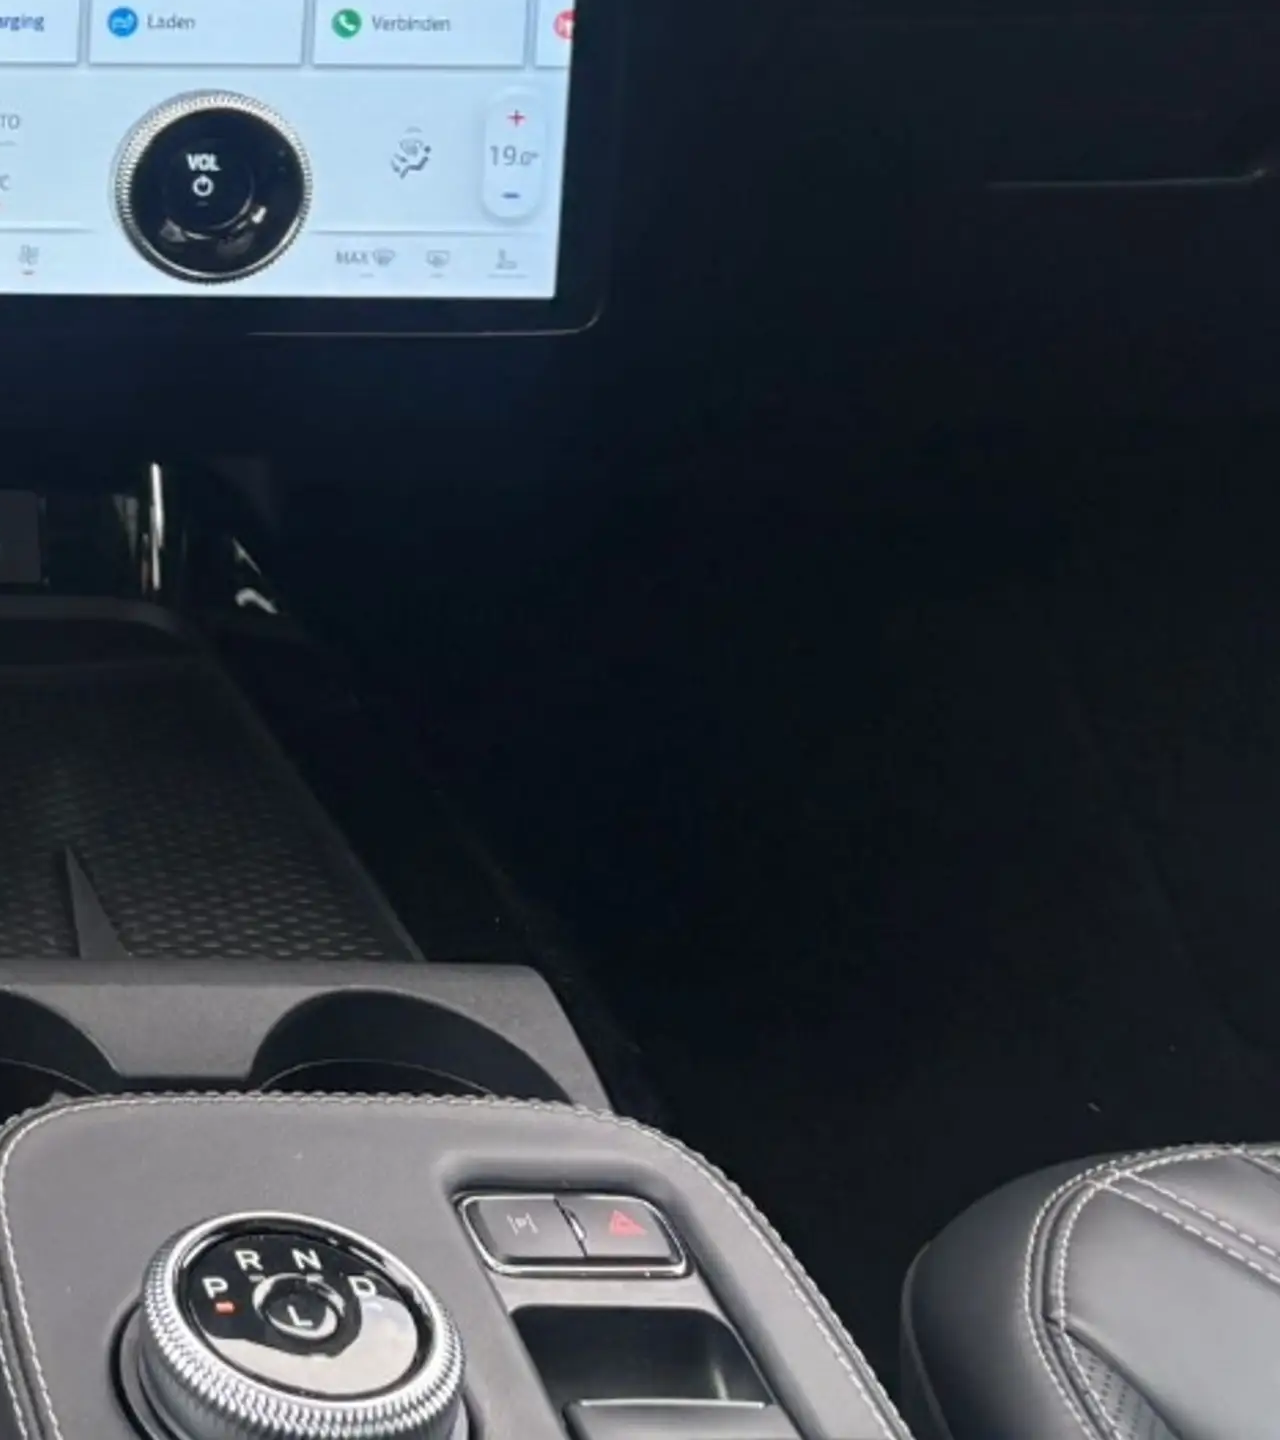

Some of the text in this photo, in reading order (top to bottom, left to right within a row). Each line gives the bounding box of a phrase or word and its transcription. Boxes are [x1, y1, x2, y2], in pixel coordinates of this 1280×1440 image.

[147, 14, 195, 30] Laden
[372, 15, 450, 31] Verbinden
[186, 154, 220, 171] VOL
[336, 251, 369, 265] MAX
[234, 1250, 264, 1272] R
[291, 1249, 324, 1271] N
[202, 1275, 229, 1299] P
[348, 1274, 379, 1298] D
[287, 1304, 314, 1329] L
